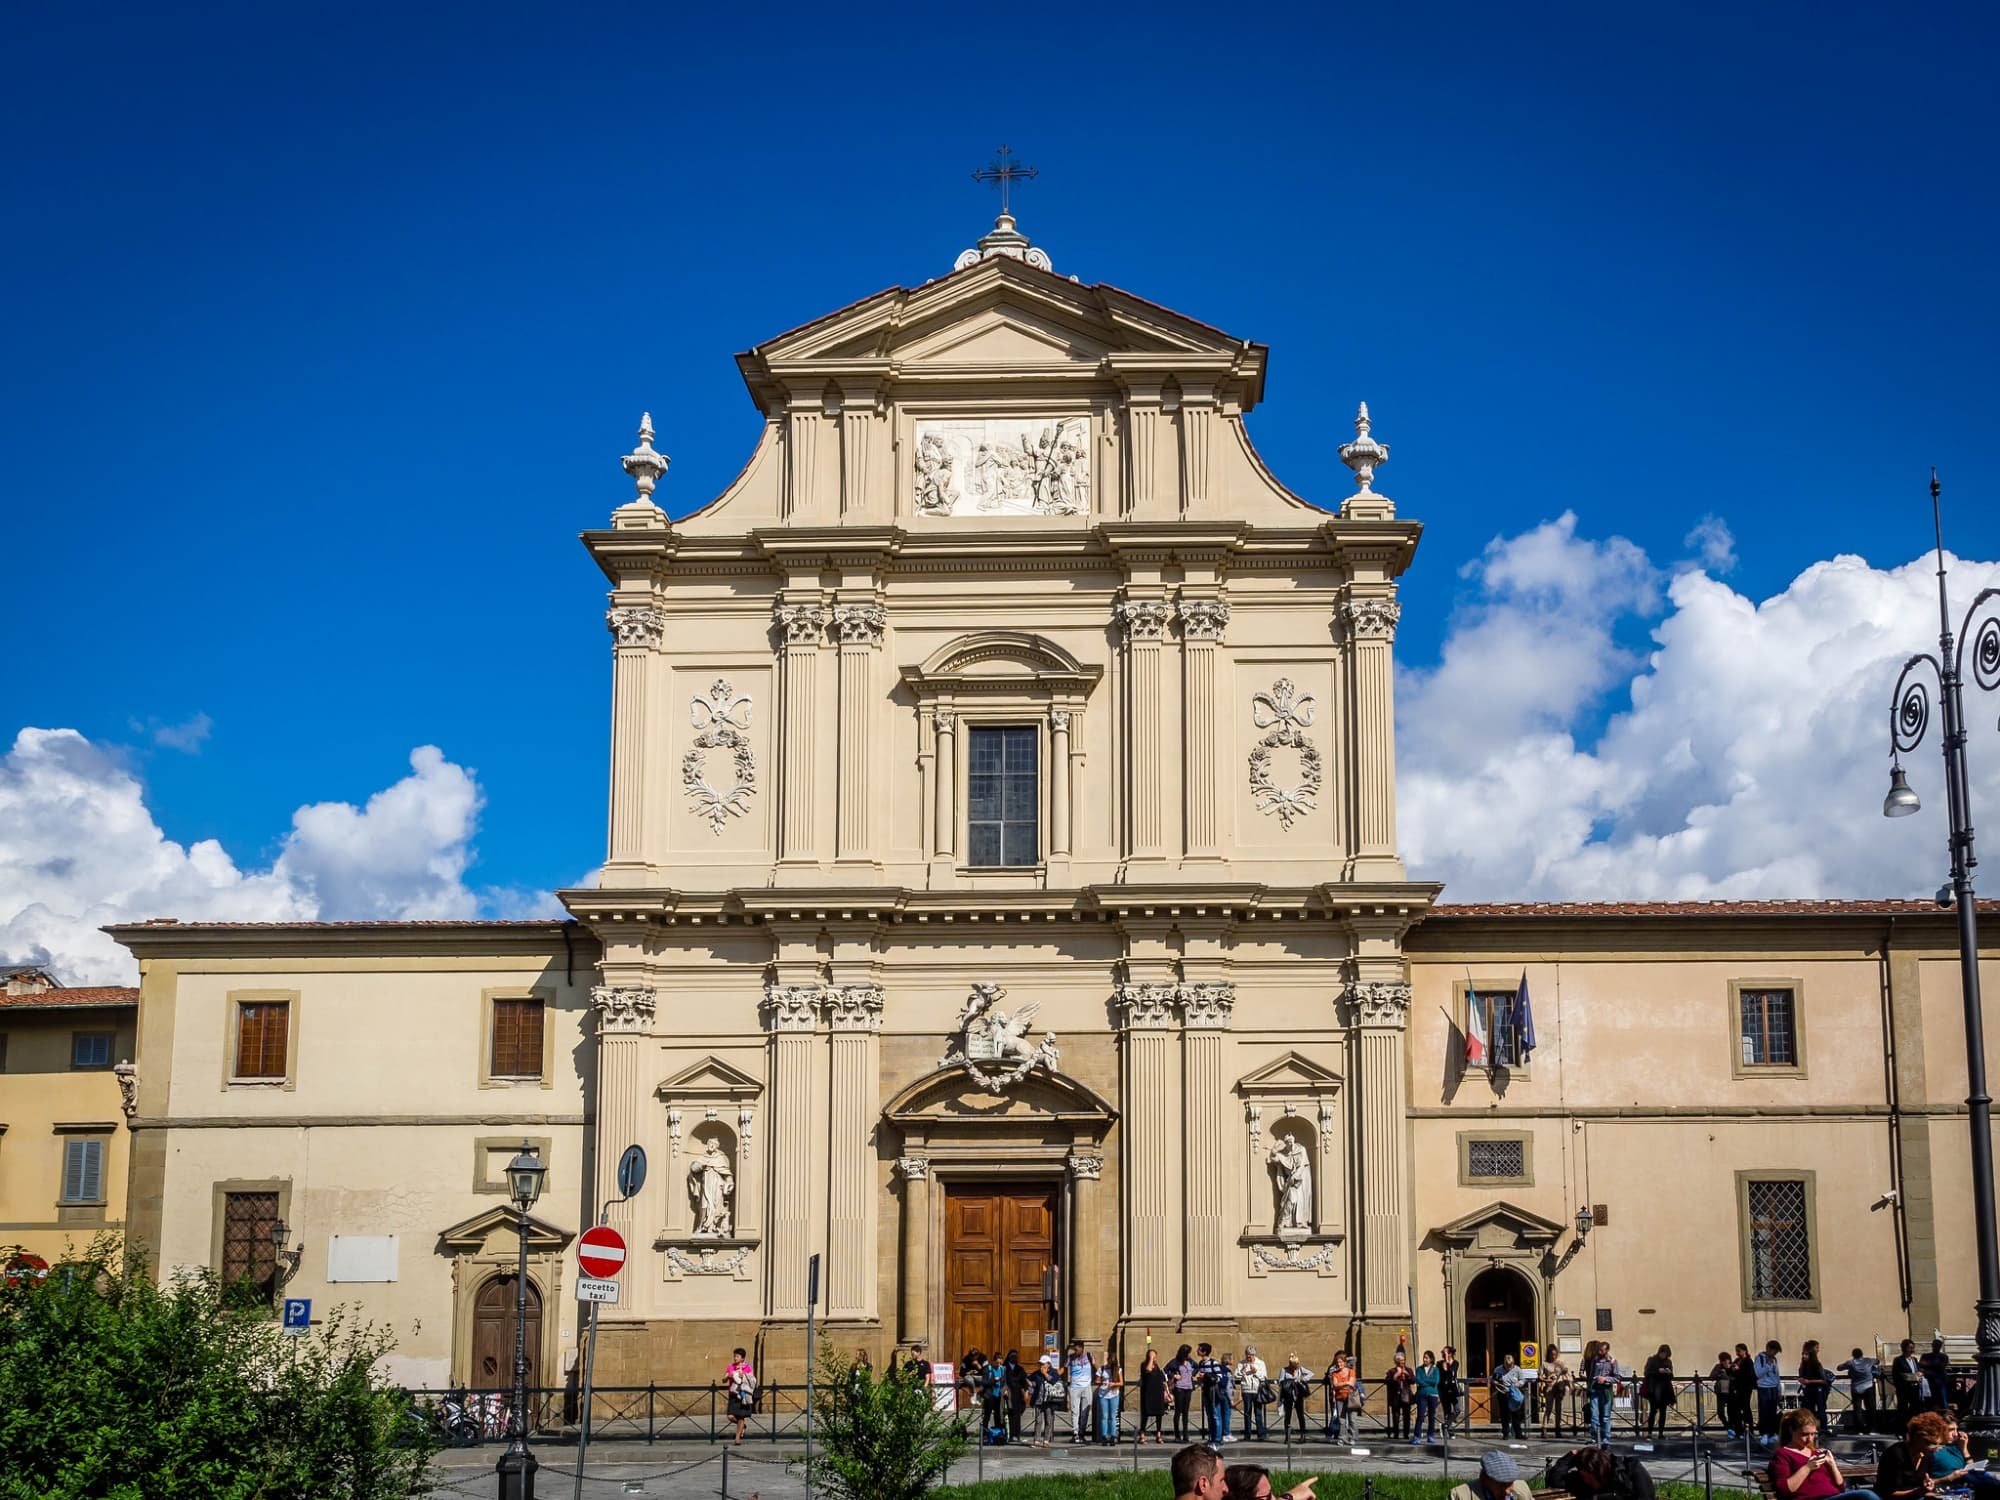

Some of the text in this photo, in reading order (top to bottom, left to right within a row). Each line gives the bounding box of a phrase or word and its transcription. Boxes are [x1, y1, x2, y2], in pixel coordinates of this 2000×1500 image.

[581, 1283, 615, 1292] eccetto
[589, 1291, 607, 1300] taxi
[288, 1302, 305, 1324] P
